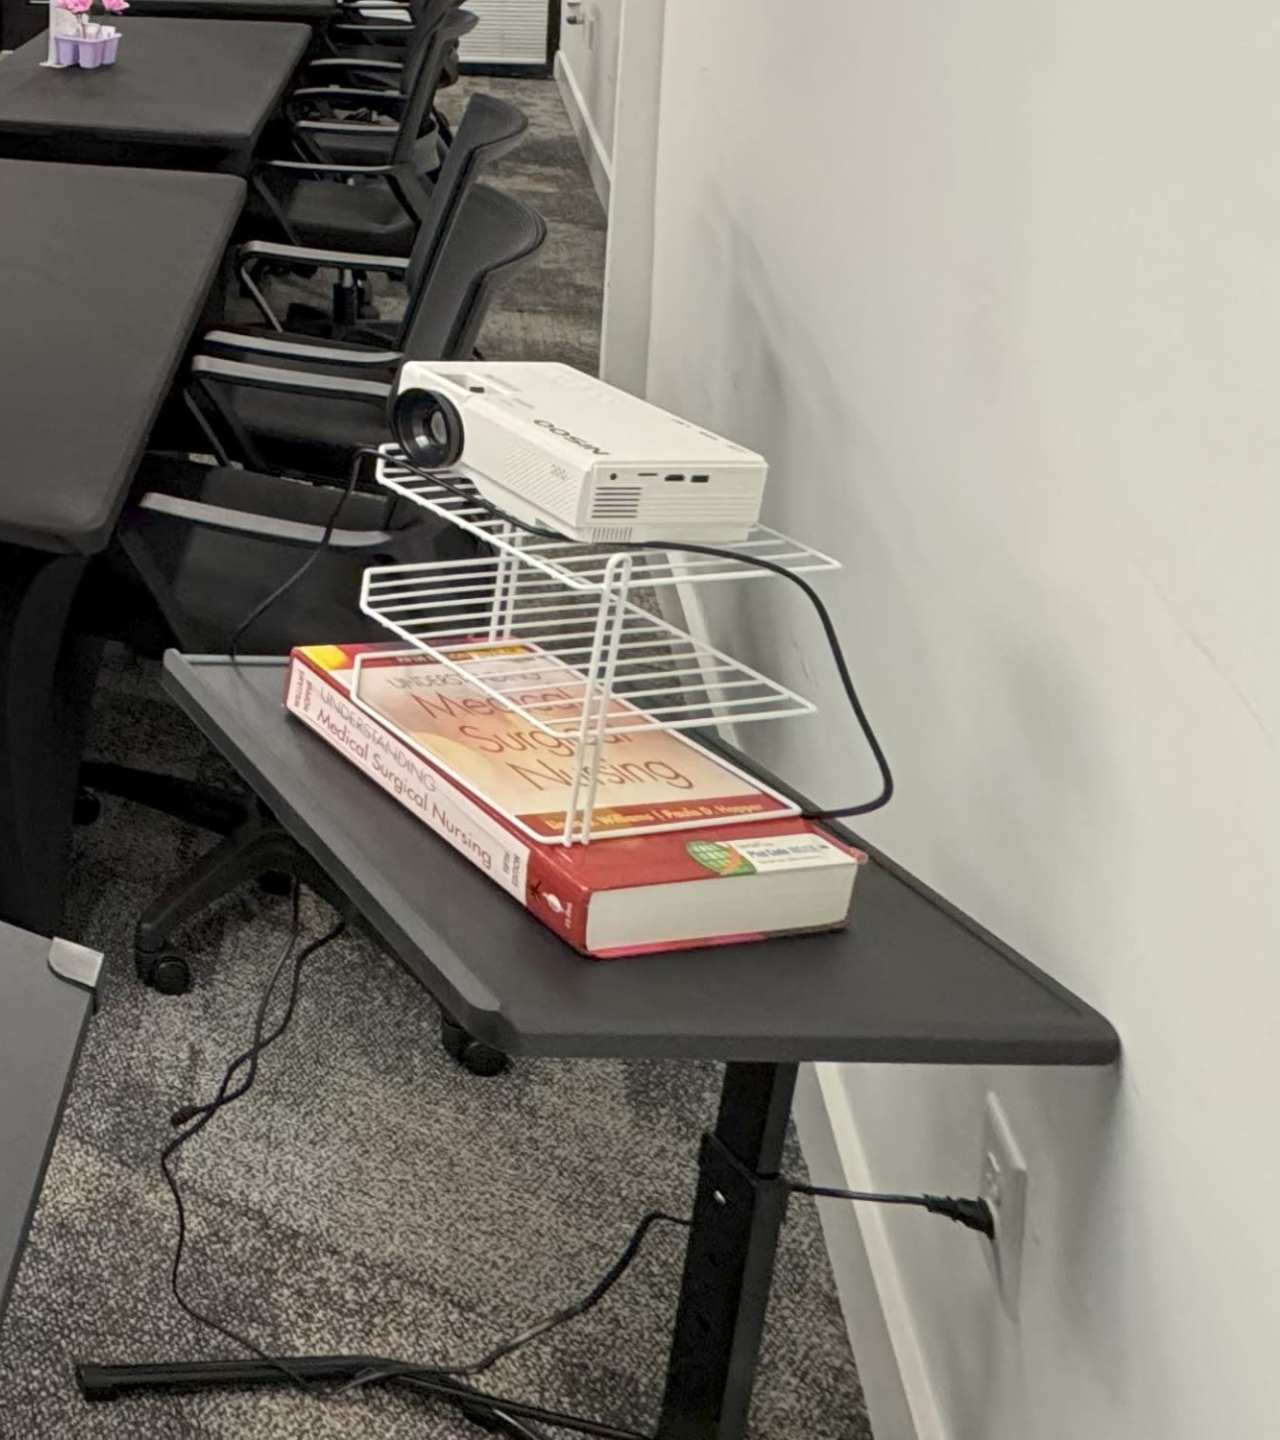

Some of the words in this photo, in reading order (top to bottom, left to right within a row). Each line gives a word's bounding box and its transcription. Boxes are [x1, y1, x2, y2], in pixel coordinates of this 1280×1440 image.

[316, 709, 369, 761] Medical
[372, 753, 428, 811] Surgical
[432, 801, 492, 871] Nursing
[320, 687, 438, 793] UNDERSTANDING
